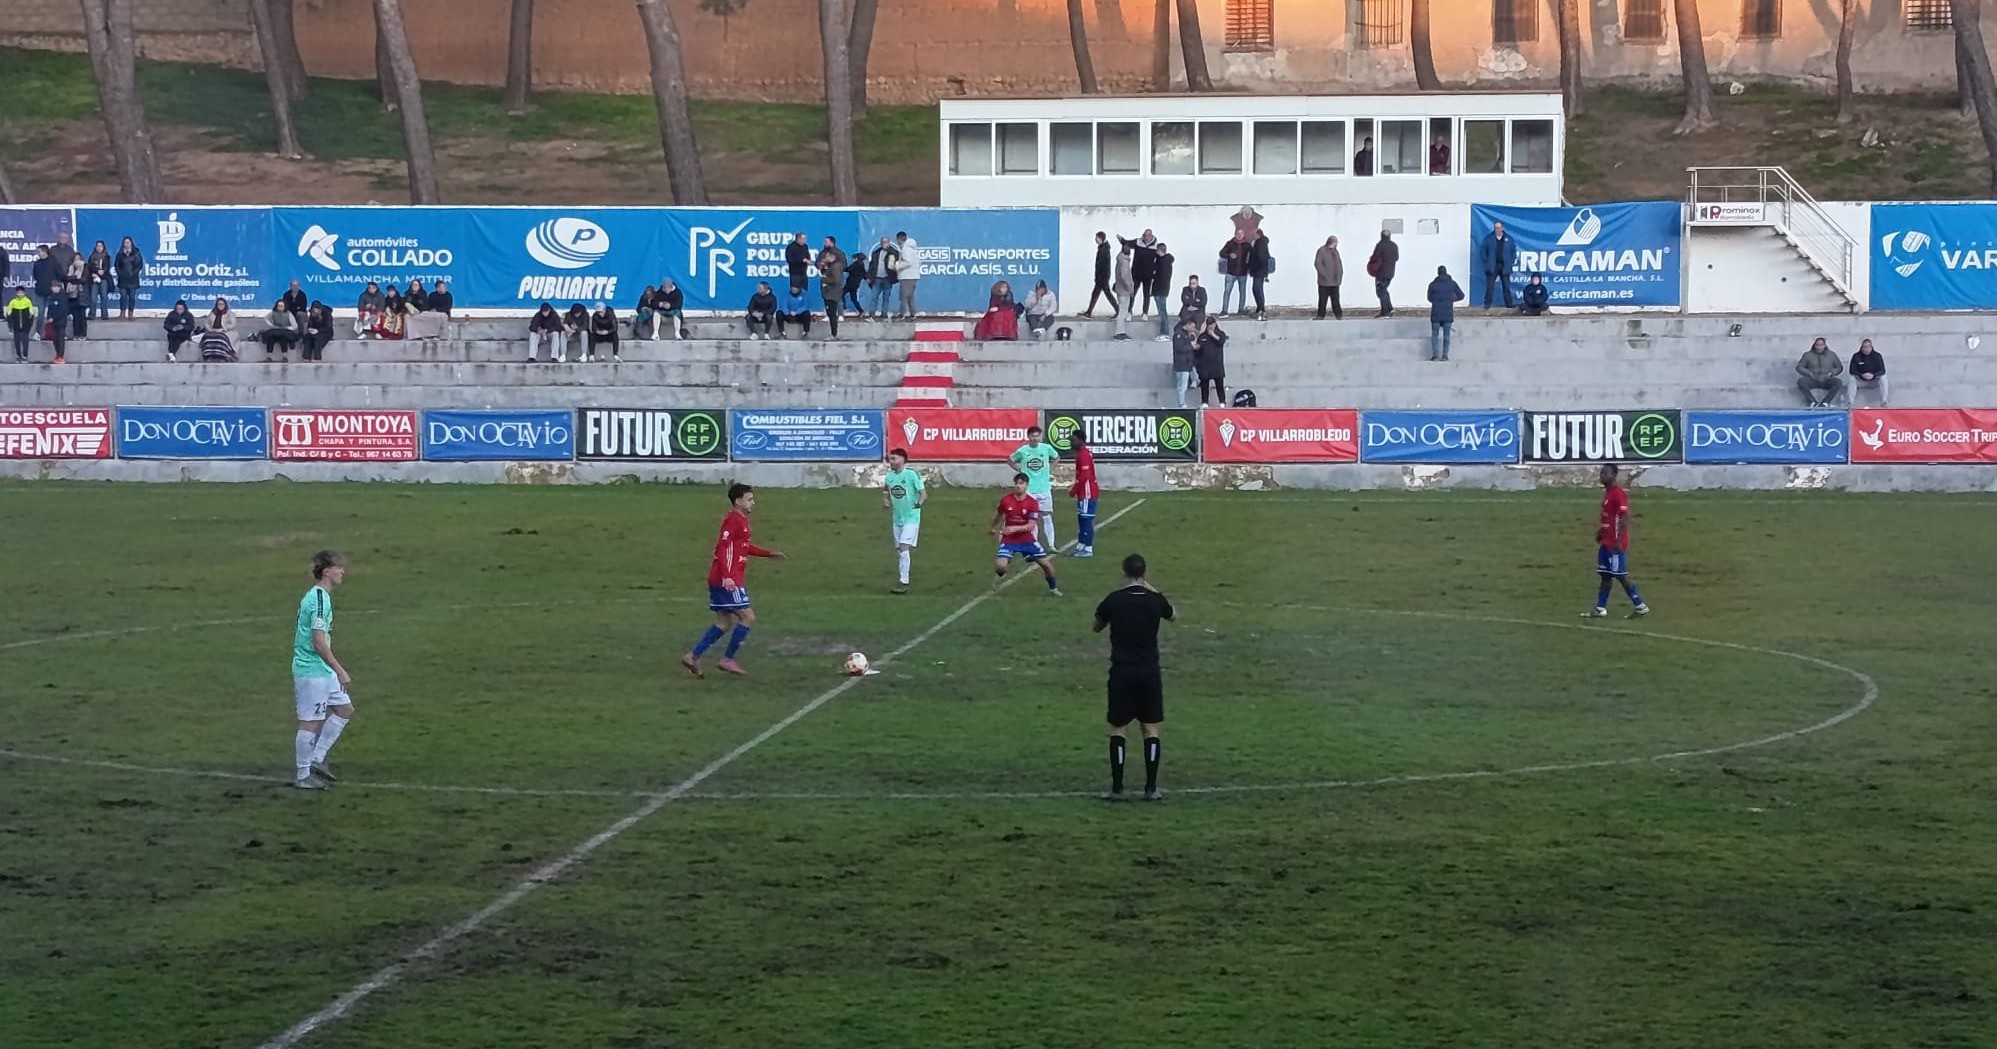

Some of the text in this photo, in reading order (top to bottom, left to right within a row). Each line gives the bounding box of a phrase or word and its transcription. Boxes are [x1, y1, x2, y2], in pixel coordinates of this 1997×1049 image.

[347, 236, 419, 248] automóviles
[746, 232, 796, 245] GRUP
[347, 249, 454, 267] COLLADO
[918, 248, 1050, 260] GASIS TRANSPORTES
[145, 263, 192, 276] Isidoro
[195, 263, 234, 277] Ortiz,
[919, 262, 1042, 277] GARCÍA ASÍS, S.L.U.
[162, 277, 211, 287] distribución
[212, 278, 222, 287] de
[305, 274, 401, 284] VILLAMANCHA
[517, 275, 618, 300] PUBLIARTE
[0, 412, 107, 425] TOESCUELA
[317, 415, 413, 433] MONTOYA
[743, 415, 869, 429] COMBUSTIBLES FIEL, S.L.
[586, 410, 672, 456] FUTUR
[923, 427, 1029, 442] CP VILLARROBLED
[1082, 415, 1158, 444] TERCERA
[1240, 428, 1351, 442] CP VILLARROBLEDO
[1888, 429, 1921, 443] EURO
[1923, 429, 1970, 443] SOCCER
[1532, 414, 1625, 460] FUTUR
